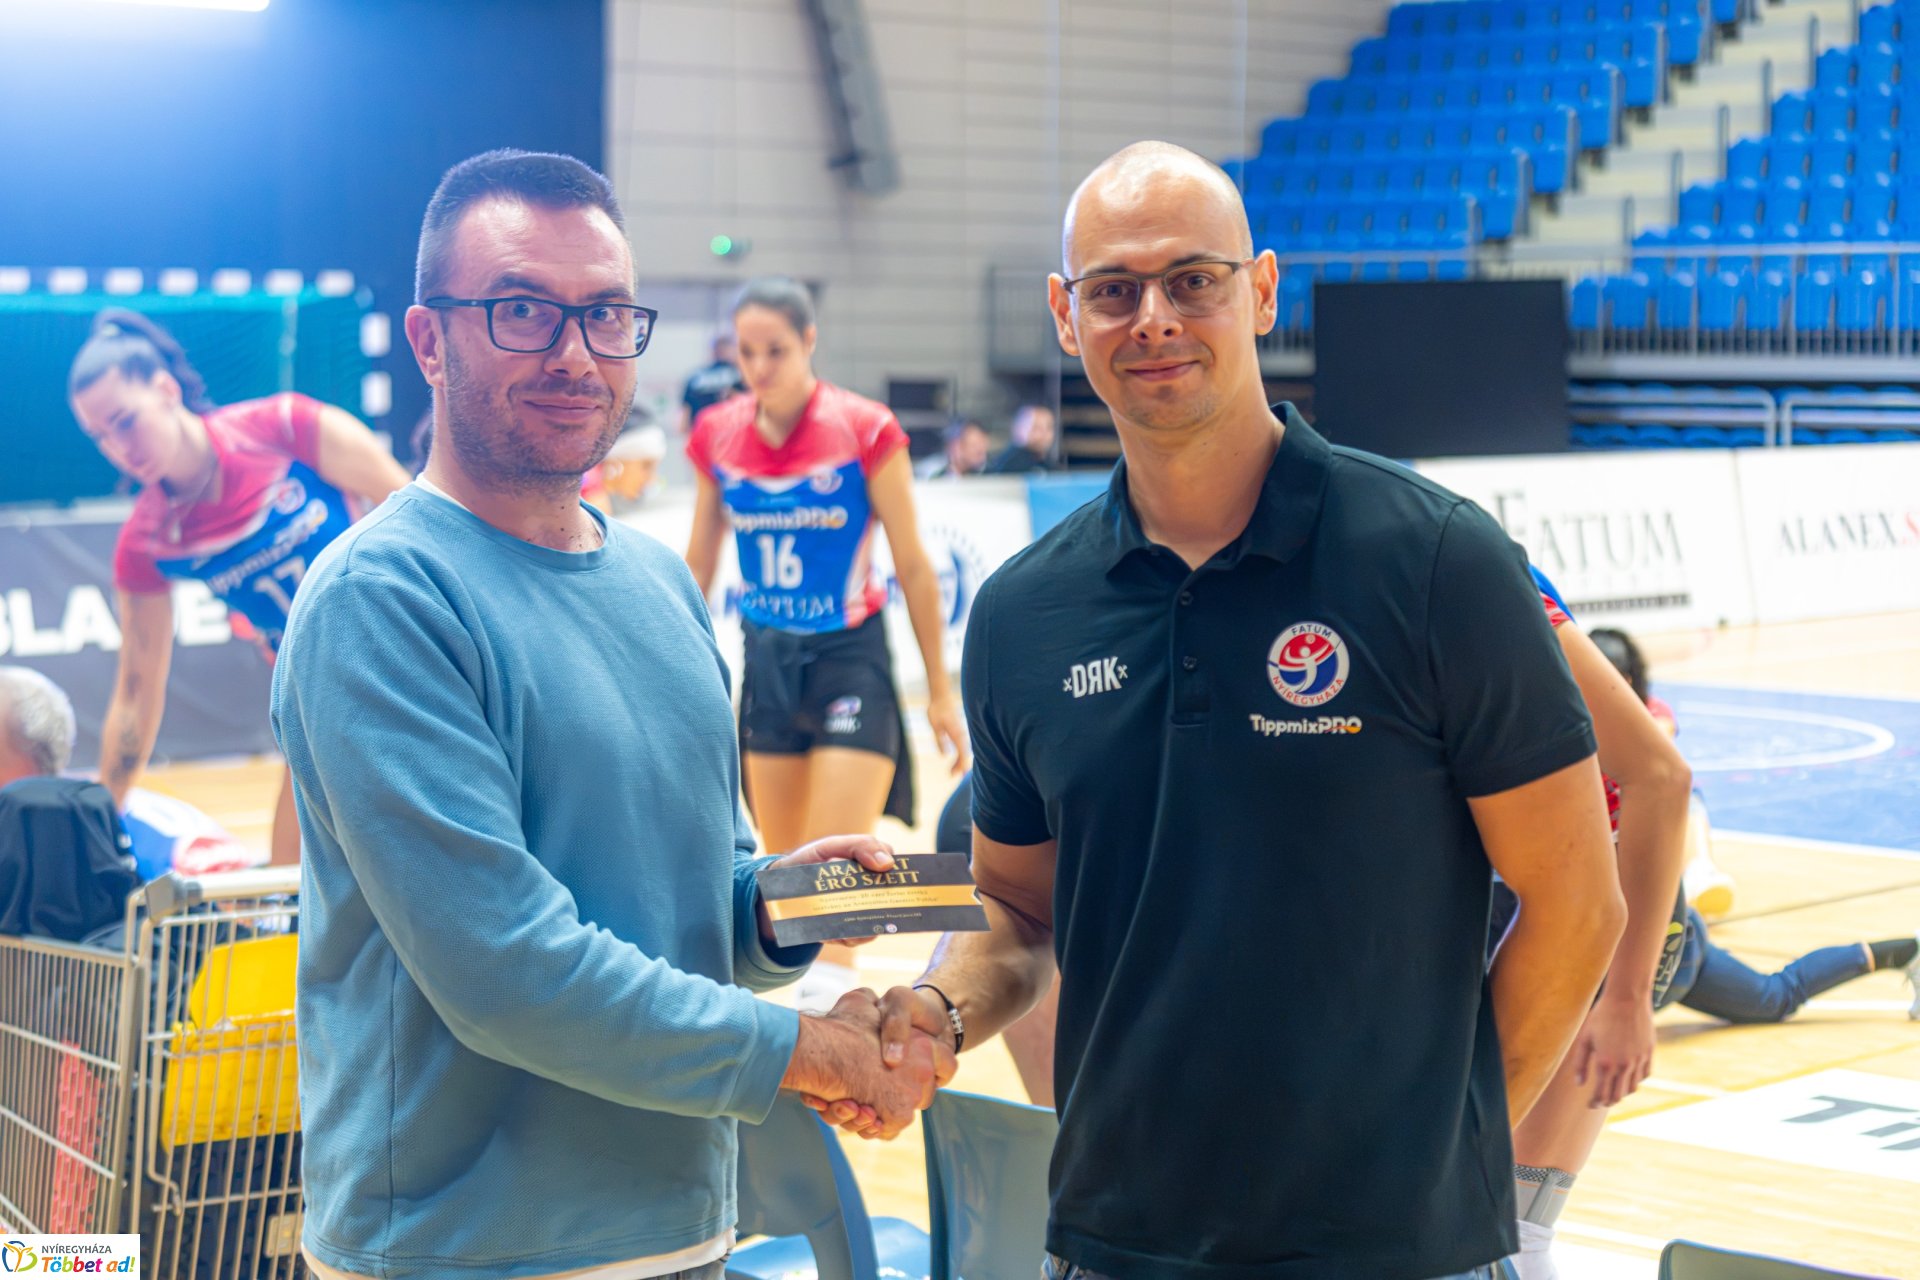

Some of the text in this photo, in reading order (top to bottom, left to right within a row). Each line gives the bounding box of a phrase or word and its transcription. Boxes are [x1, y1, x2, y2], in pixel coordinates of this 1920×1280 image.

[758, 534, 803, 588] 16
[0, 580, 232, 657] LAE
[1291, 624, 1332, 639] FATUM
[1273, 675, 1345, 705] NYÍREGYHÁZA
[1249, 714, 1362, 736] TippmixPRO
[861, 871, 920, 886] SZETT
